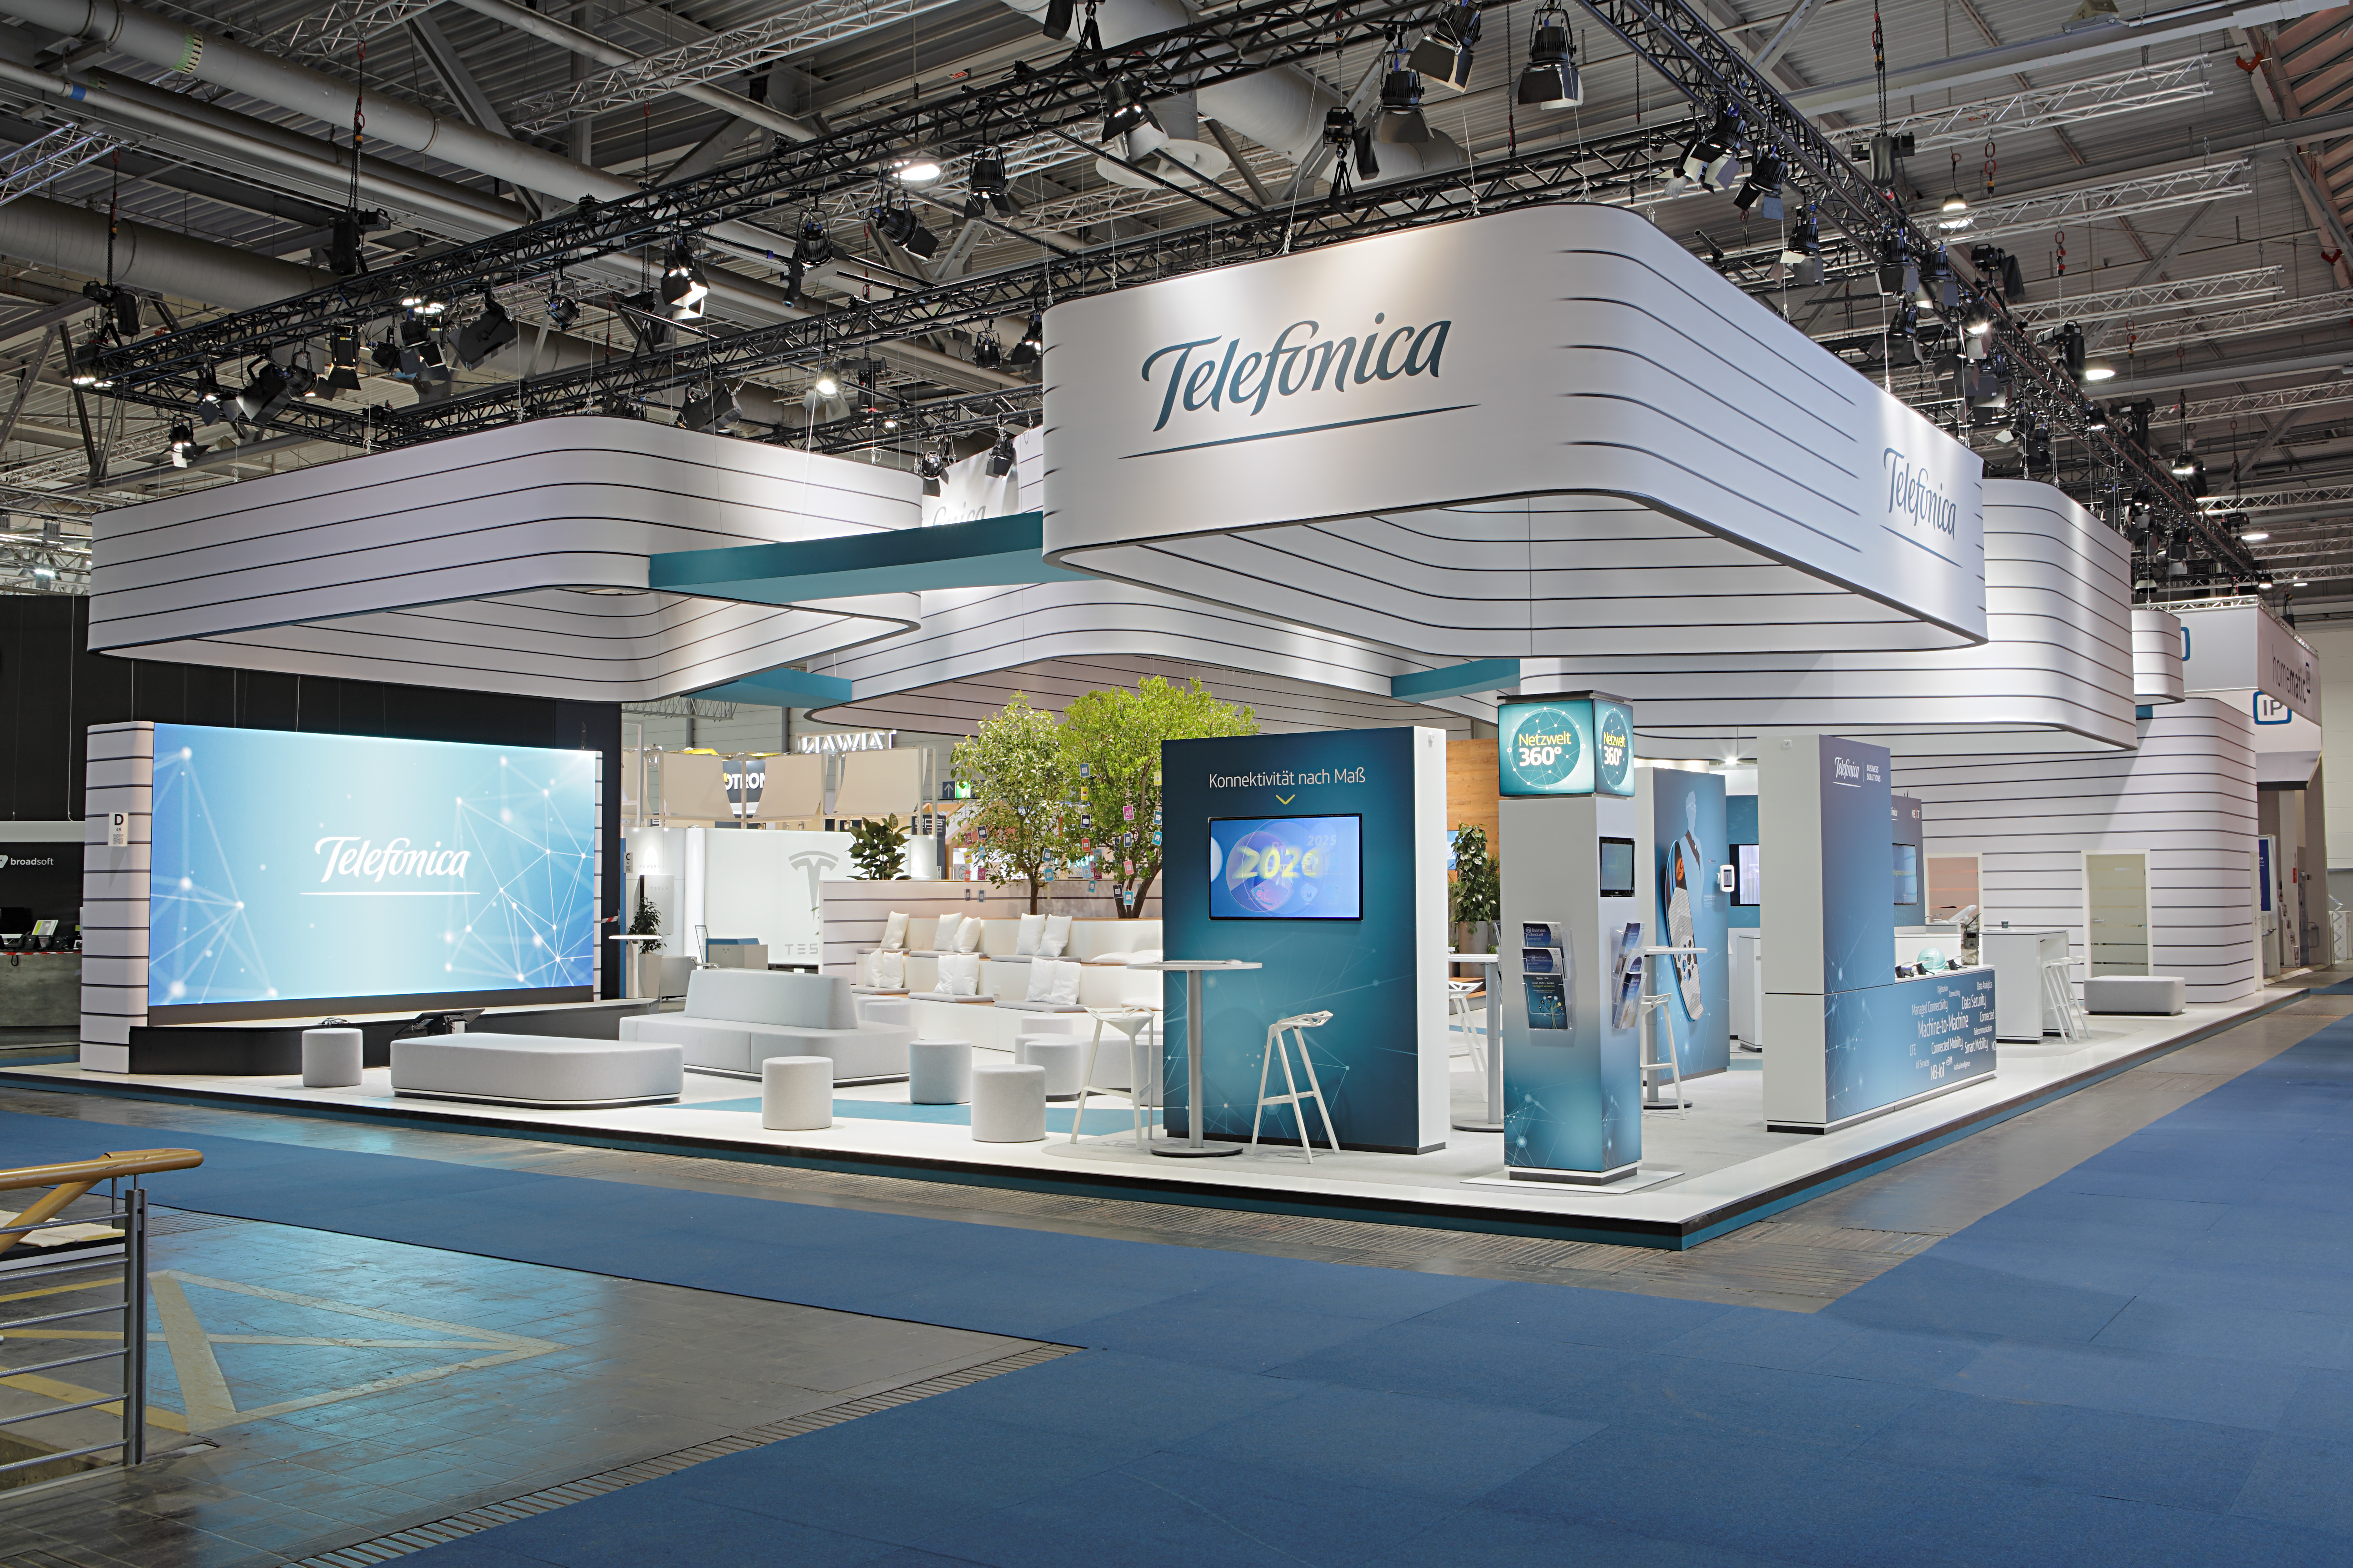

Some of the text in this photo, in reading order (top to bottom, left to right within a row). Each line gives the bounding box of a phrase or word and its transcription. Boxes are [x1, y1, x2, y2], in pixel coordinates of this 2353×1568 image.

[2272, 643, 2306, 704] homematic
[2263, 700, 2283, 716] IP
[1519, 730, 1572, 746] Netzwelt
[1604, 732, 1626, 748] Netzwelt
[1519, 746, 1562, 766] 360°
[1604, 746, 1622, 766] 360°
[1866, 764, 1879, 773] BUSINESS
[1209, 767, 1365, 788] Konnektivität nach Maß
[1866, 773, 1881, 782] SOLUTIONS
[115, 814, 124, 825] D
[1983, 980, 1993, 991] Analytics
[1912, 998, 1948, 1018] Managed Connectivity
[1962, 993, 1986, 1010] Data Security
[1980, 1008, 1995, 1022] Connected
[1918, 1012, 1968, 1038] Machine-to-Machine
[1931, 1035, 1963, 1055] Connected Mobility
[1965, 1037, 1988, 1054] Smart Mobility
[1920, 1059, 1930, 1068] Services
[1930, 1062, 1945, 1080] NB-IoT
